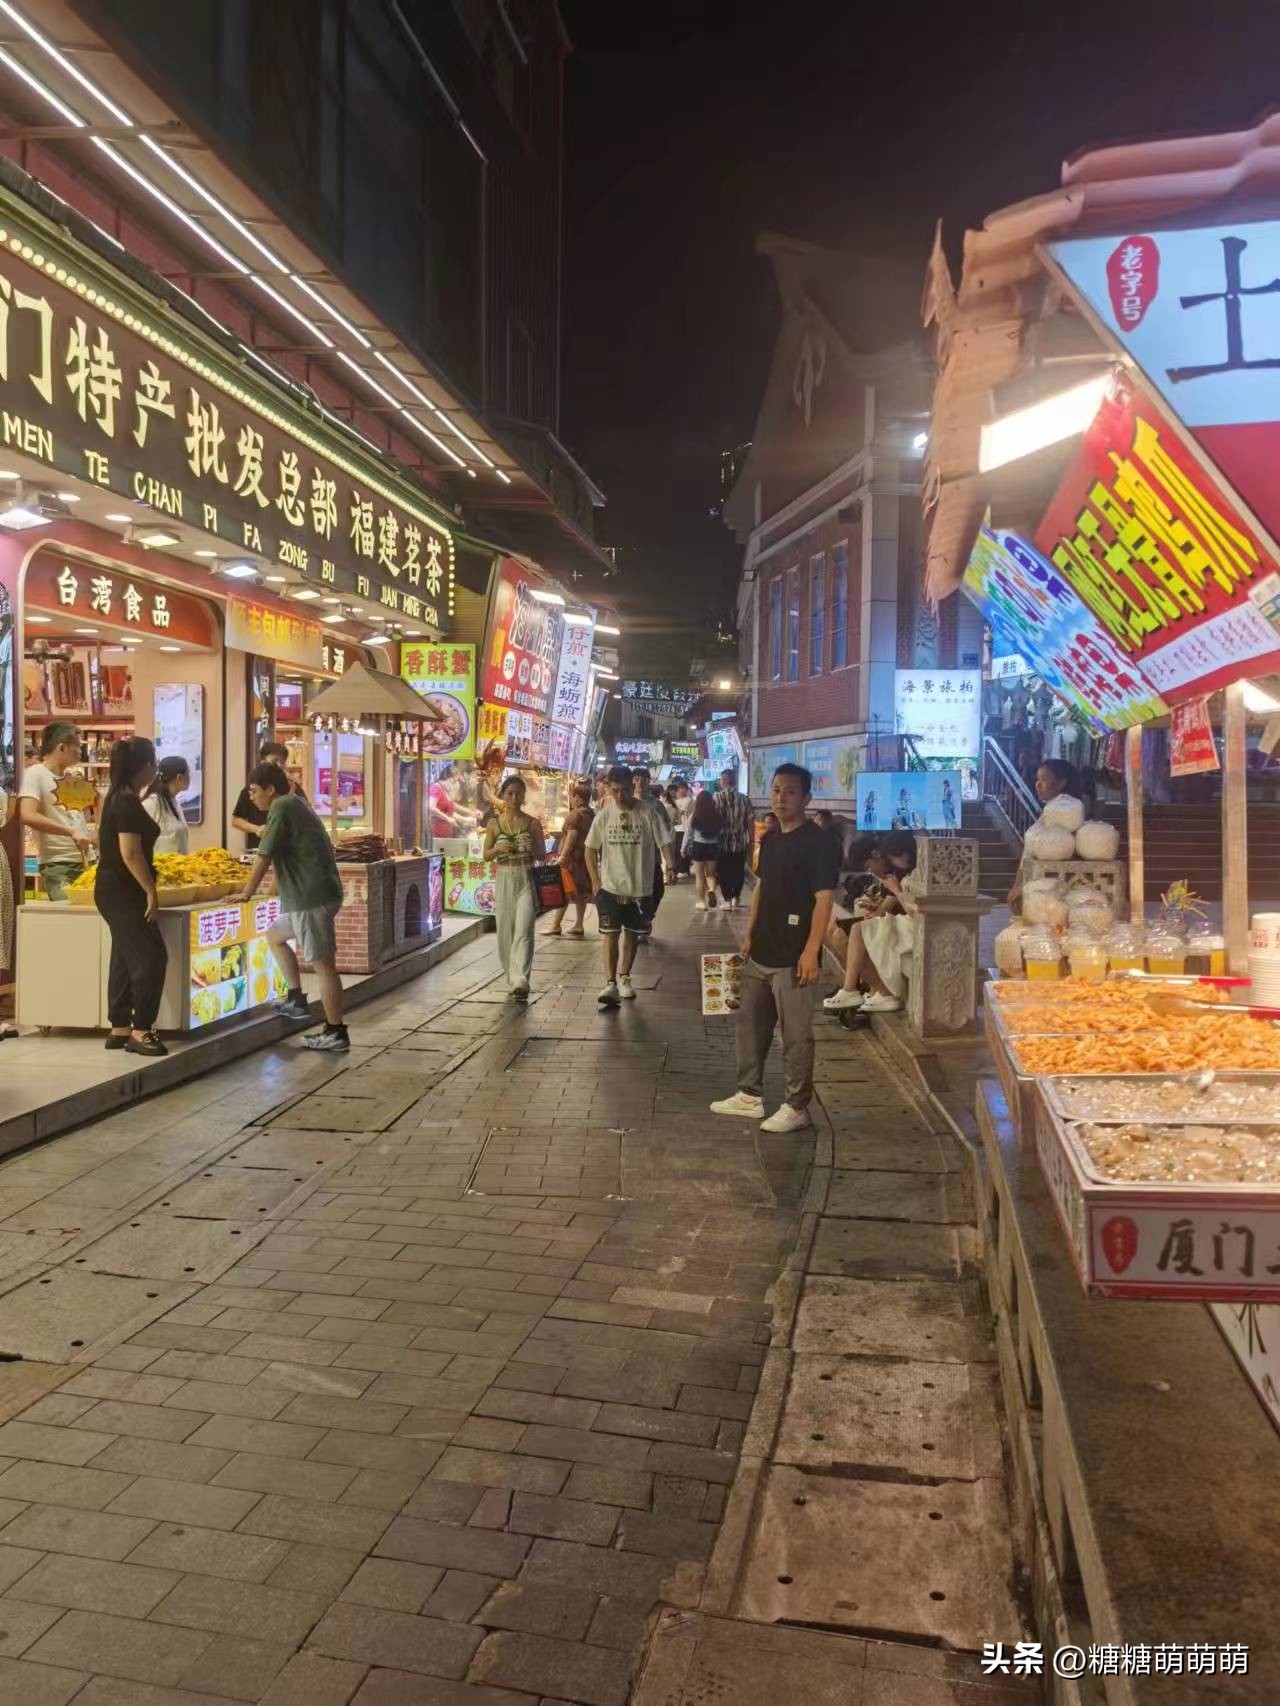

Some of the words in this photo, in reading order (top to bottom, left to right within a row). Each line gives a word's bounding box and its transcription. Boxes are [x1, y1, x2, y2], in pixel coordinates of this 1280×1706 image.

[1120, 245, 1143, 321] 老字号
[3, 411, 54, 462] MEN
[84, 449, 110, 485] TE
[134, 472, 183, 517] CHAN
[203, 503, 217, 532] PI
[243, 522, 262, 552] FA
[278, 540, 308, 571] ZONG
[322, 559, 335, 582] BU
[358, 575, 369, 597] FU
[380, 585, 397, 608] JIAN
[402, 595, 420, 617] MING
[424, 607, 438, 627] CHA
[350, 490, 443, 597] 福建茗茶
[1051, 416, 1261, 654] 网红无骨鸡爪
[57, 566, 170, 628] 台湾食品
[405, 648, 471, 676] 香酥蟹
[902, 680, 974, 693] 海景旅拍
[199, 909, 240, 945] 菠萝干
